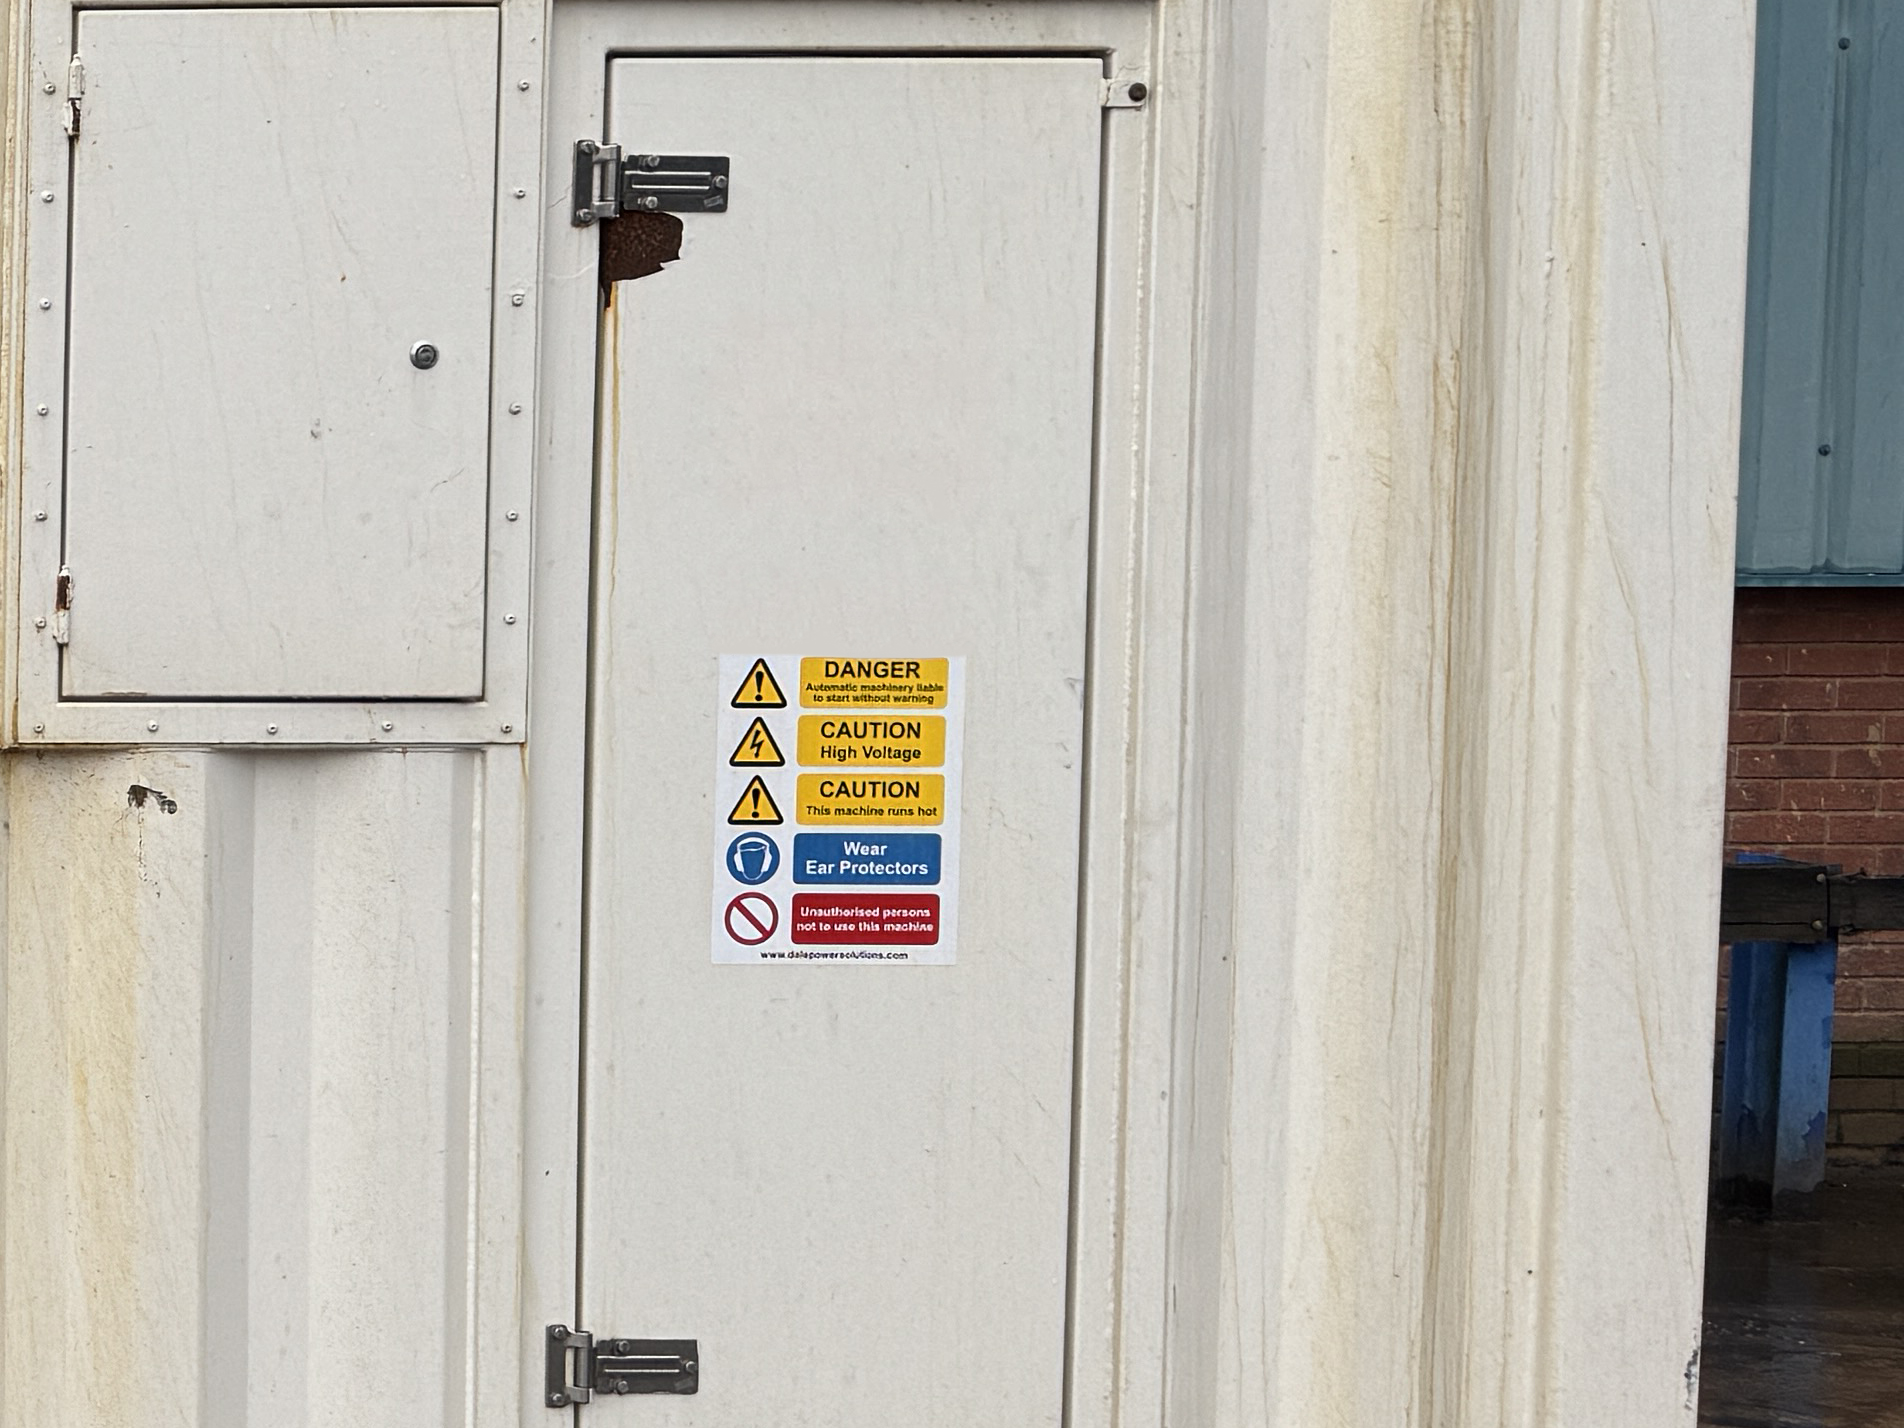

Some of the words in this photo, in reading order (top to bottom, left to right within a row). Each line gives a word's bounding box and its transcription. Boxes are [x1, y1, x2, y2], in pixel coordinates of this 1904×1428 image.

[824, 660, 921, 679] DANGER
[805, 682, 857, 692] Automatic
[860, 682, 913, 693] machinery
[916, 682, 944, 692] liable
[813, 694, 824, 702] to
[826, 694, 850, 702] start
[852, 693, 891, 703] without
[893, 693, 934, 705] warning
[820, 721, 921, 739] CAUTION
[820, 745, 857, 762] High
[862, 745, 922, 763] Voltage
[819, 780, 920, 798] CAUTION
[806, 805, 831, 816] This
[834, 805, 884, 816] machine
[887, 806, 914, 816] runs
[917, 806, 938, 816] hot
[843, 841, 888, 856] Wear
[805, 860, 835, 875] Ear
[839, 860, 929, 875] Protectors
[800, 906, 880, 917] Unauthorised
[882, 907, 931, 919] persons
[796, 922, 817, 932] not
[819, 922, 829, 932] to
[833, 923, 856, 932] use
[858, 922, 880, 932] this
[883, 922, 934, 932] machine
